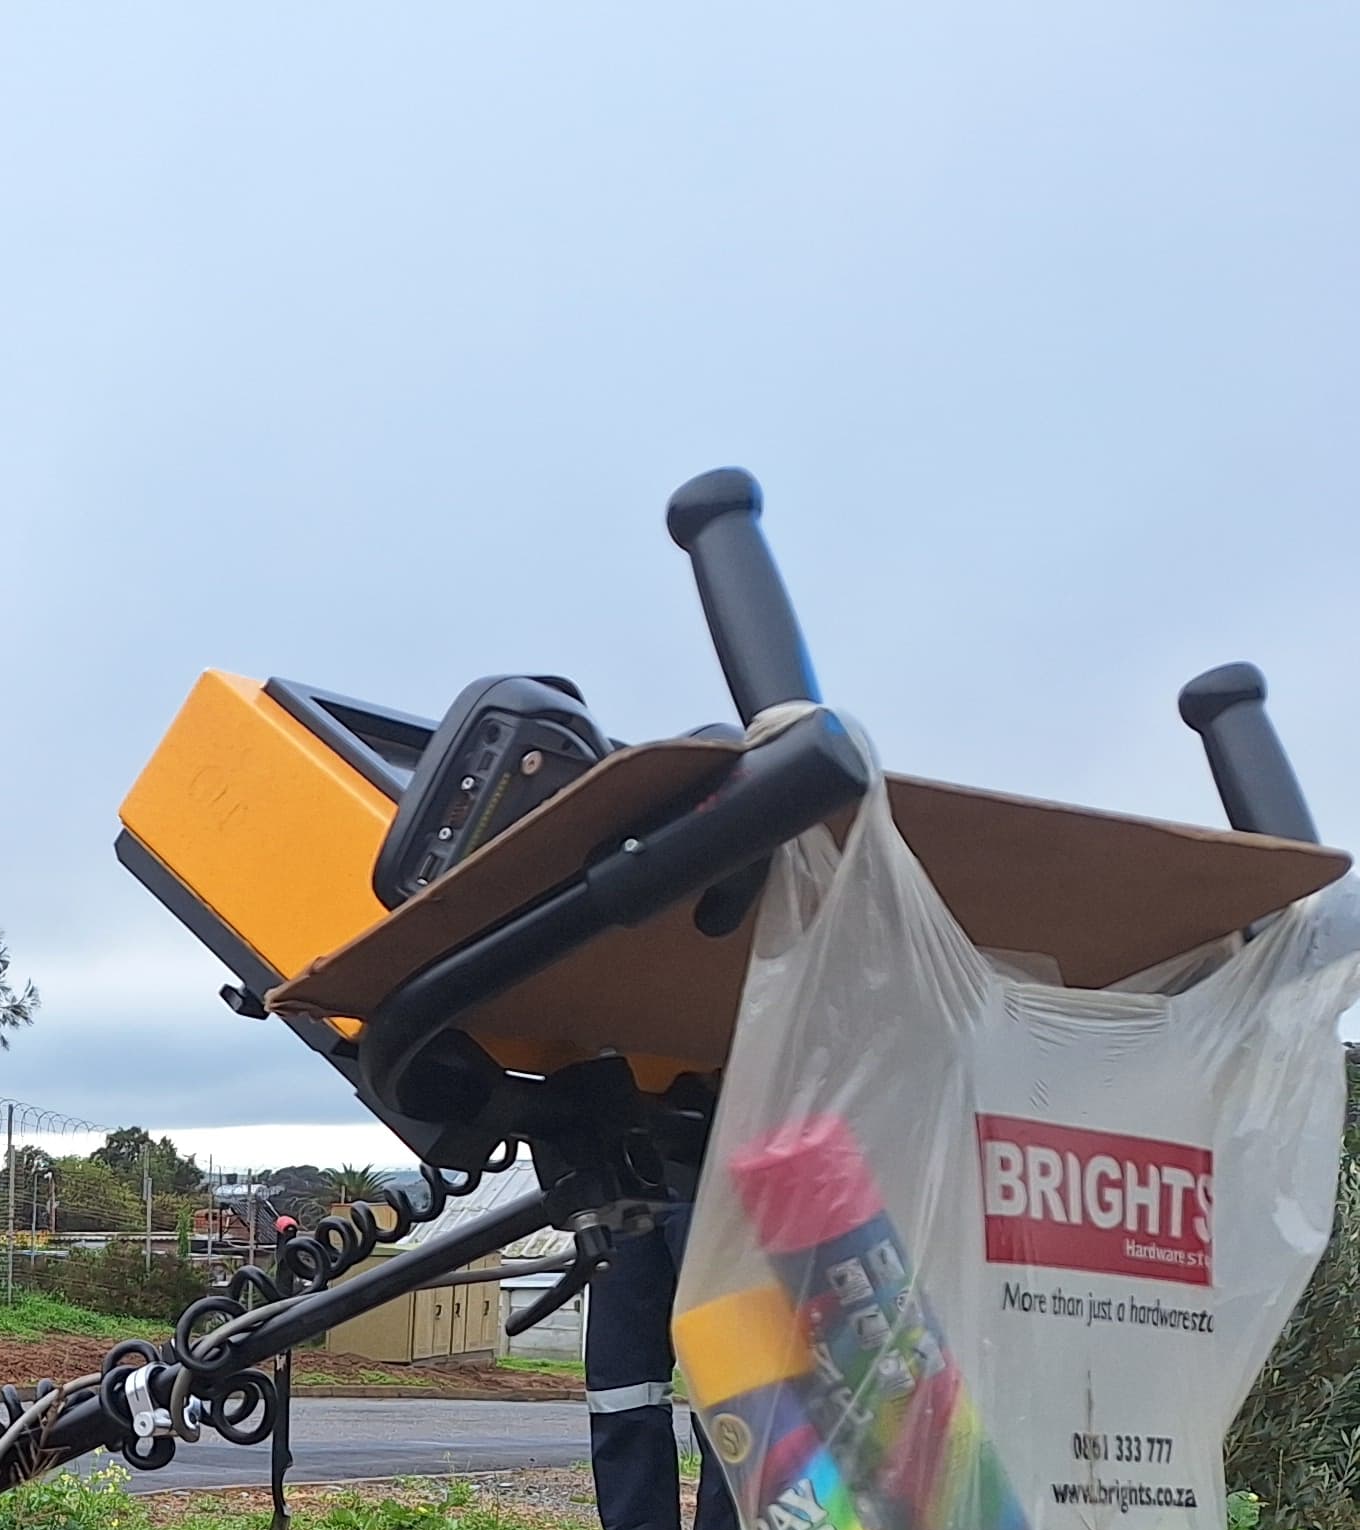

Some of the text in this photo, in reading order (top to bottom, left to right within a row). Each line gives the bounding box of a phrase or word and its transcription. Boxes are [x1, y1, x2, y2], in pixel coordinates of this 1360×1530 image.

[1002, 1282, 1047, 1313] More
[1052, 1287, 1083, 1317] than
[1087, 1292, 1112, 1327] just
[1117, 1303, 1125, 1321] a
[1115, 1434, 1142, 1463] 333
[1147, 1437, 1173, 1464] 777
